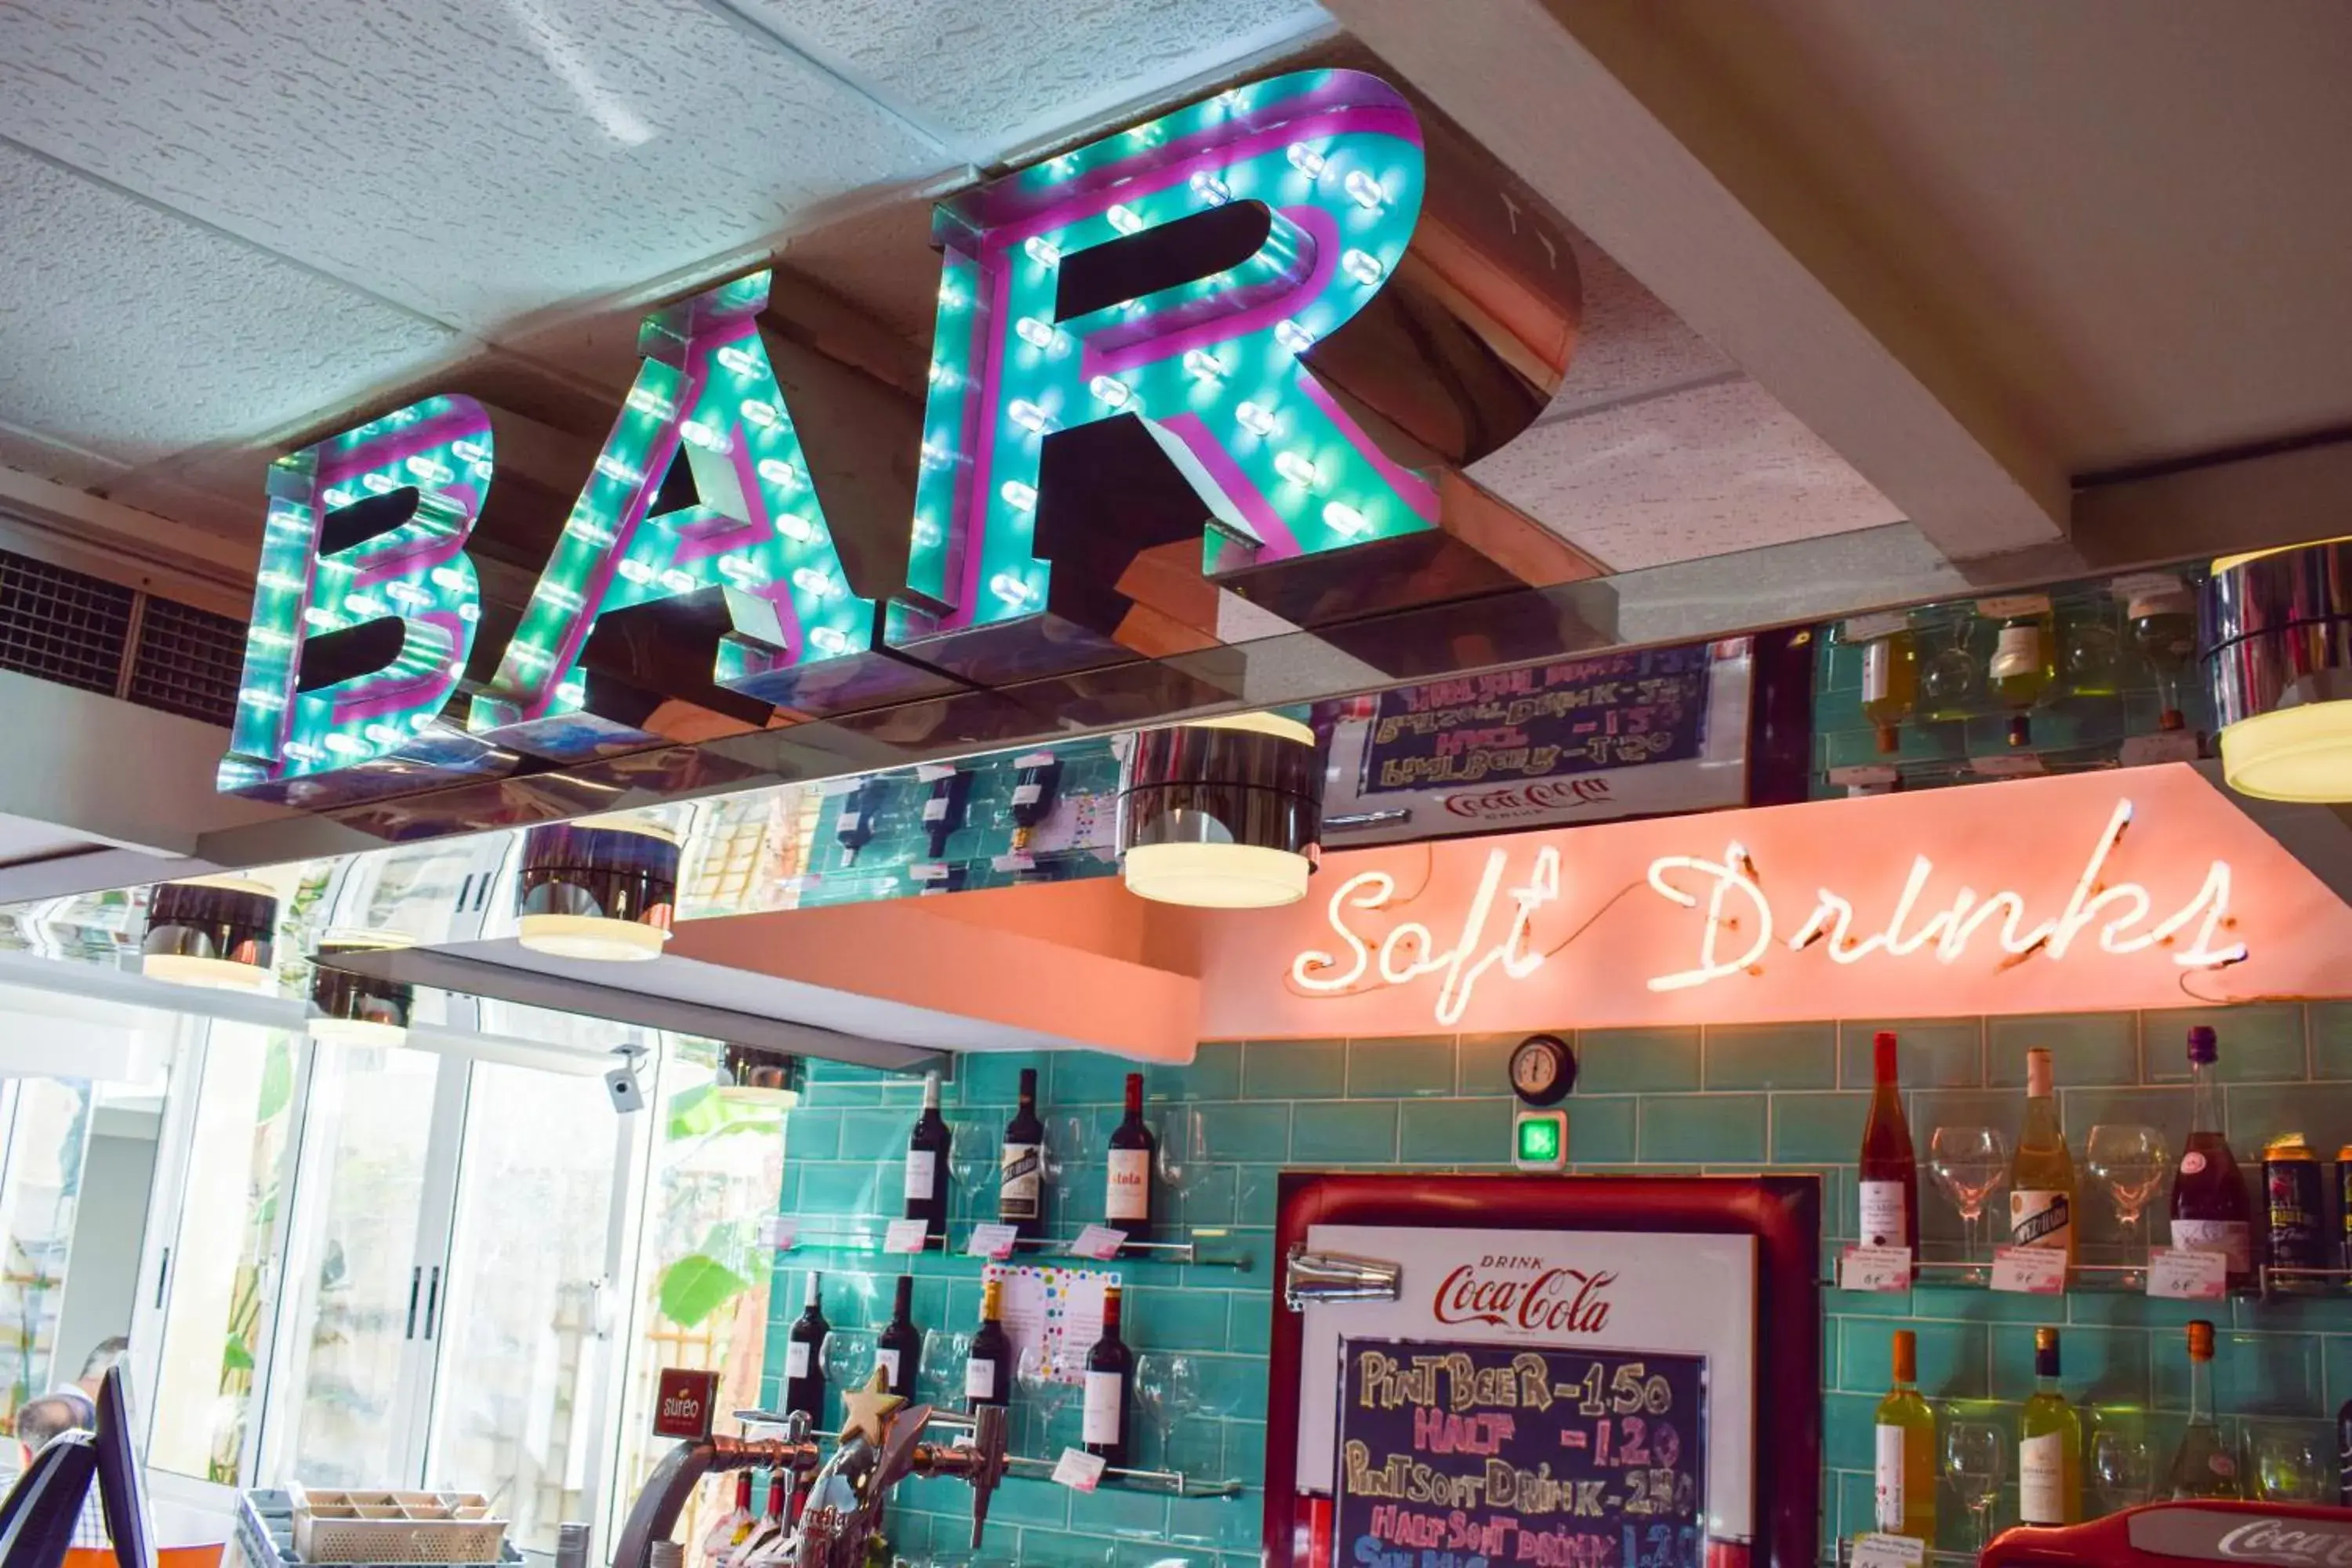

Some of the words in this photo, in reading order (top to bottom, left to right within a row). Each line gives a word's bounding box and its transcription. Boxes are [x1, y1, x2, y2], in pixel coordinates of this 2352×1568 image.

[217, 67, 1443, 792] BAR
[1292, 846, 1561, 1025] Soft
[1648, 797, 2248, 991] Drinks
[1480, 1255, 1542, 1269] DRINK
[1433, 1265, 1619, 1333] Coca-Cola
[1446, 1352, 1553, 1411] BEER
